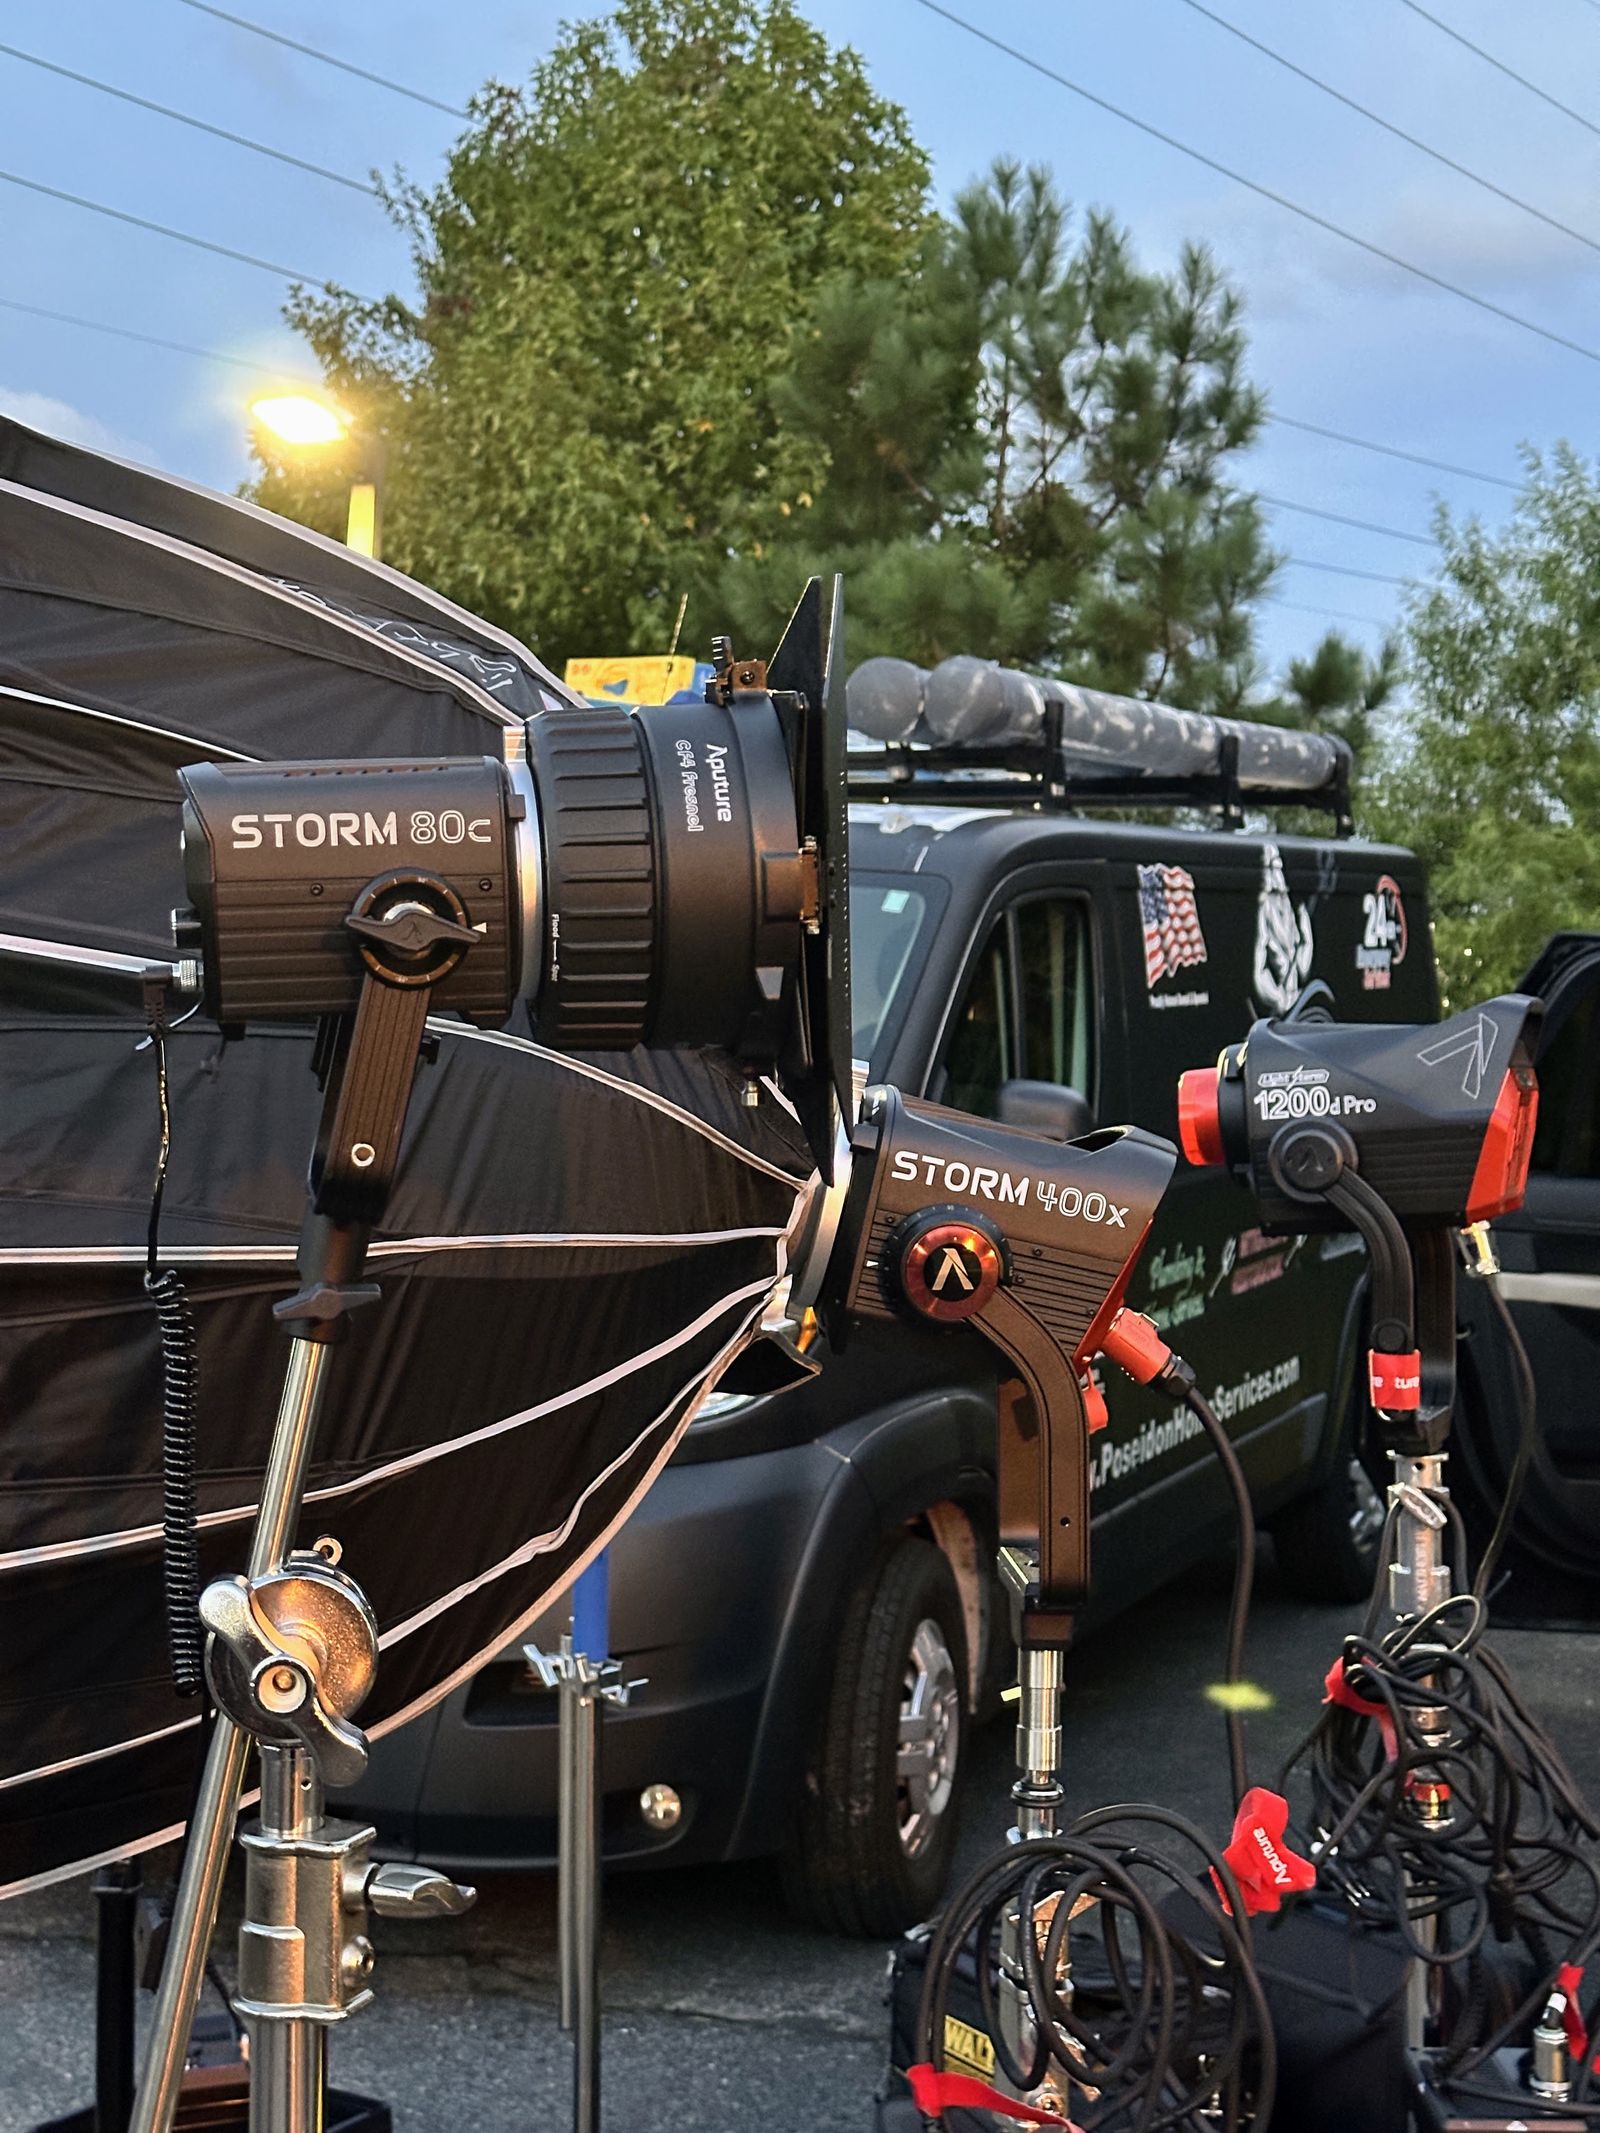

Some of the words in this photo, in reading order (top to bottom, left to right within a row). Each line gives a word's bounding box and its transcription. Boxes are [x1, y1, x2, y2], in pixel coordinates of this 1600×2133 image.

[705, 744, 732, 822] Aputure
[231, 811, 398, 849] STORM
[410, 809, 492, 845] 80c
[551, 913, 560, 938] Flood
[1363, 893, 1387, 948] 24
[1343, 1094, 1377, 1115] Pro
[891, 1150, 1030, 1206] STORM
[1036, 1180, 1130, 1229] 400x
[1253, 1826, 1292, 1885] Aputure
